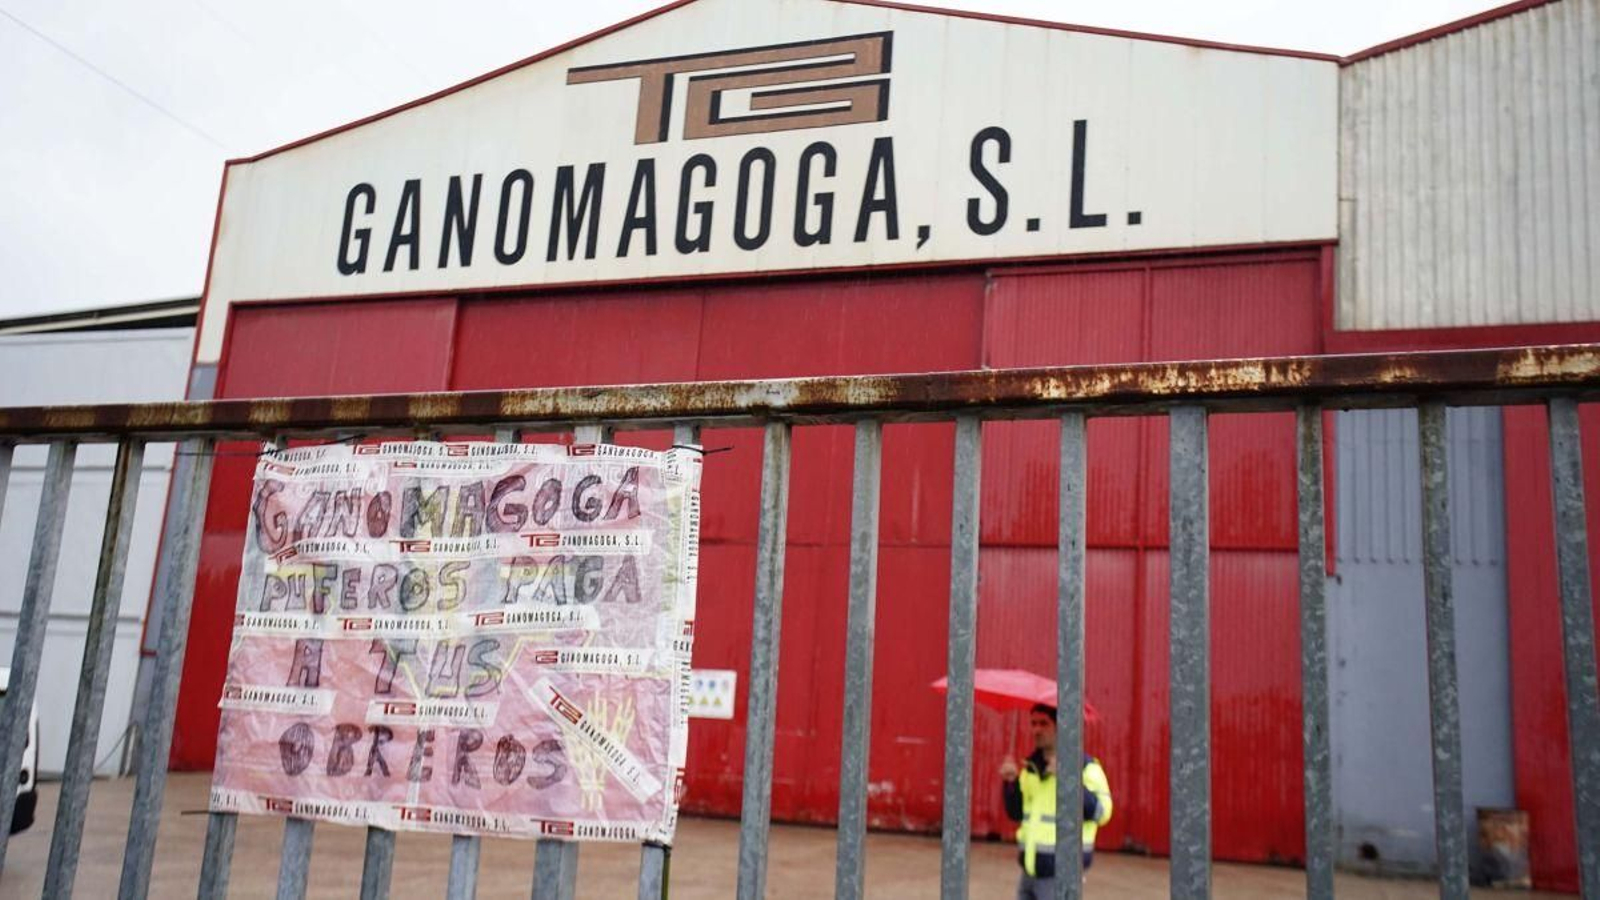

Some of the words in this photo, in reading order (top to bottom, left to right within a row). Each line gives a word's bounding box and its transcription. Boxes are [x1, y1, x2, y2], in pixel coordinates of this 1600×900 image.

[337, 136, 931, 276] GANOMAGOGA,
[253, 466, 642, 556] GANOMAGOGA
[501, 554, 643, 605] PAGA
[368, 638, 502, 700] TUS
[278, 721, 568, 791] OBREROS
